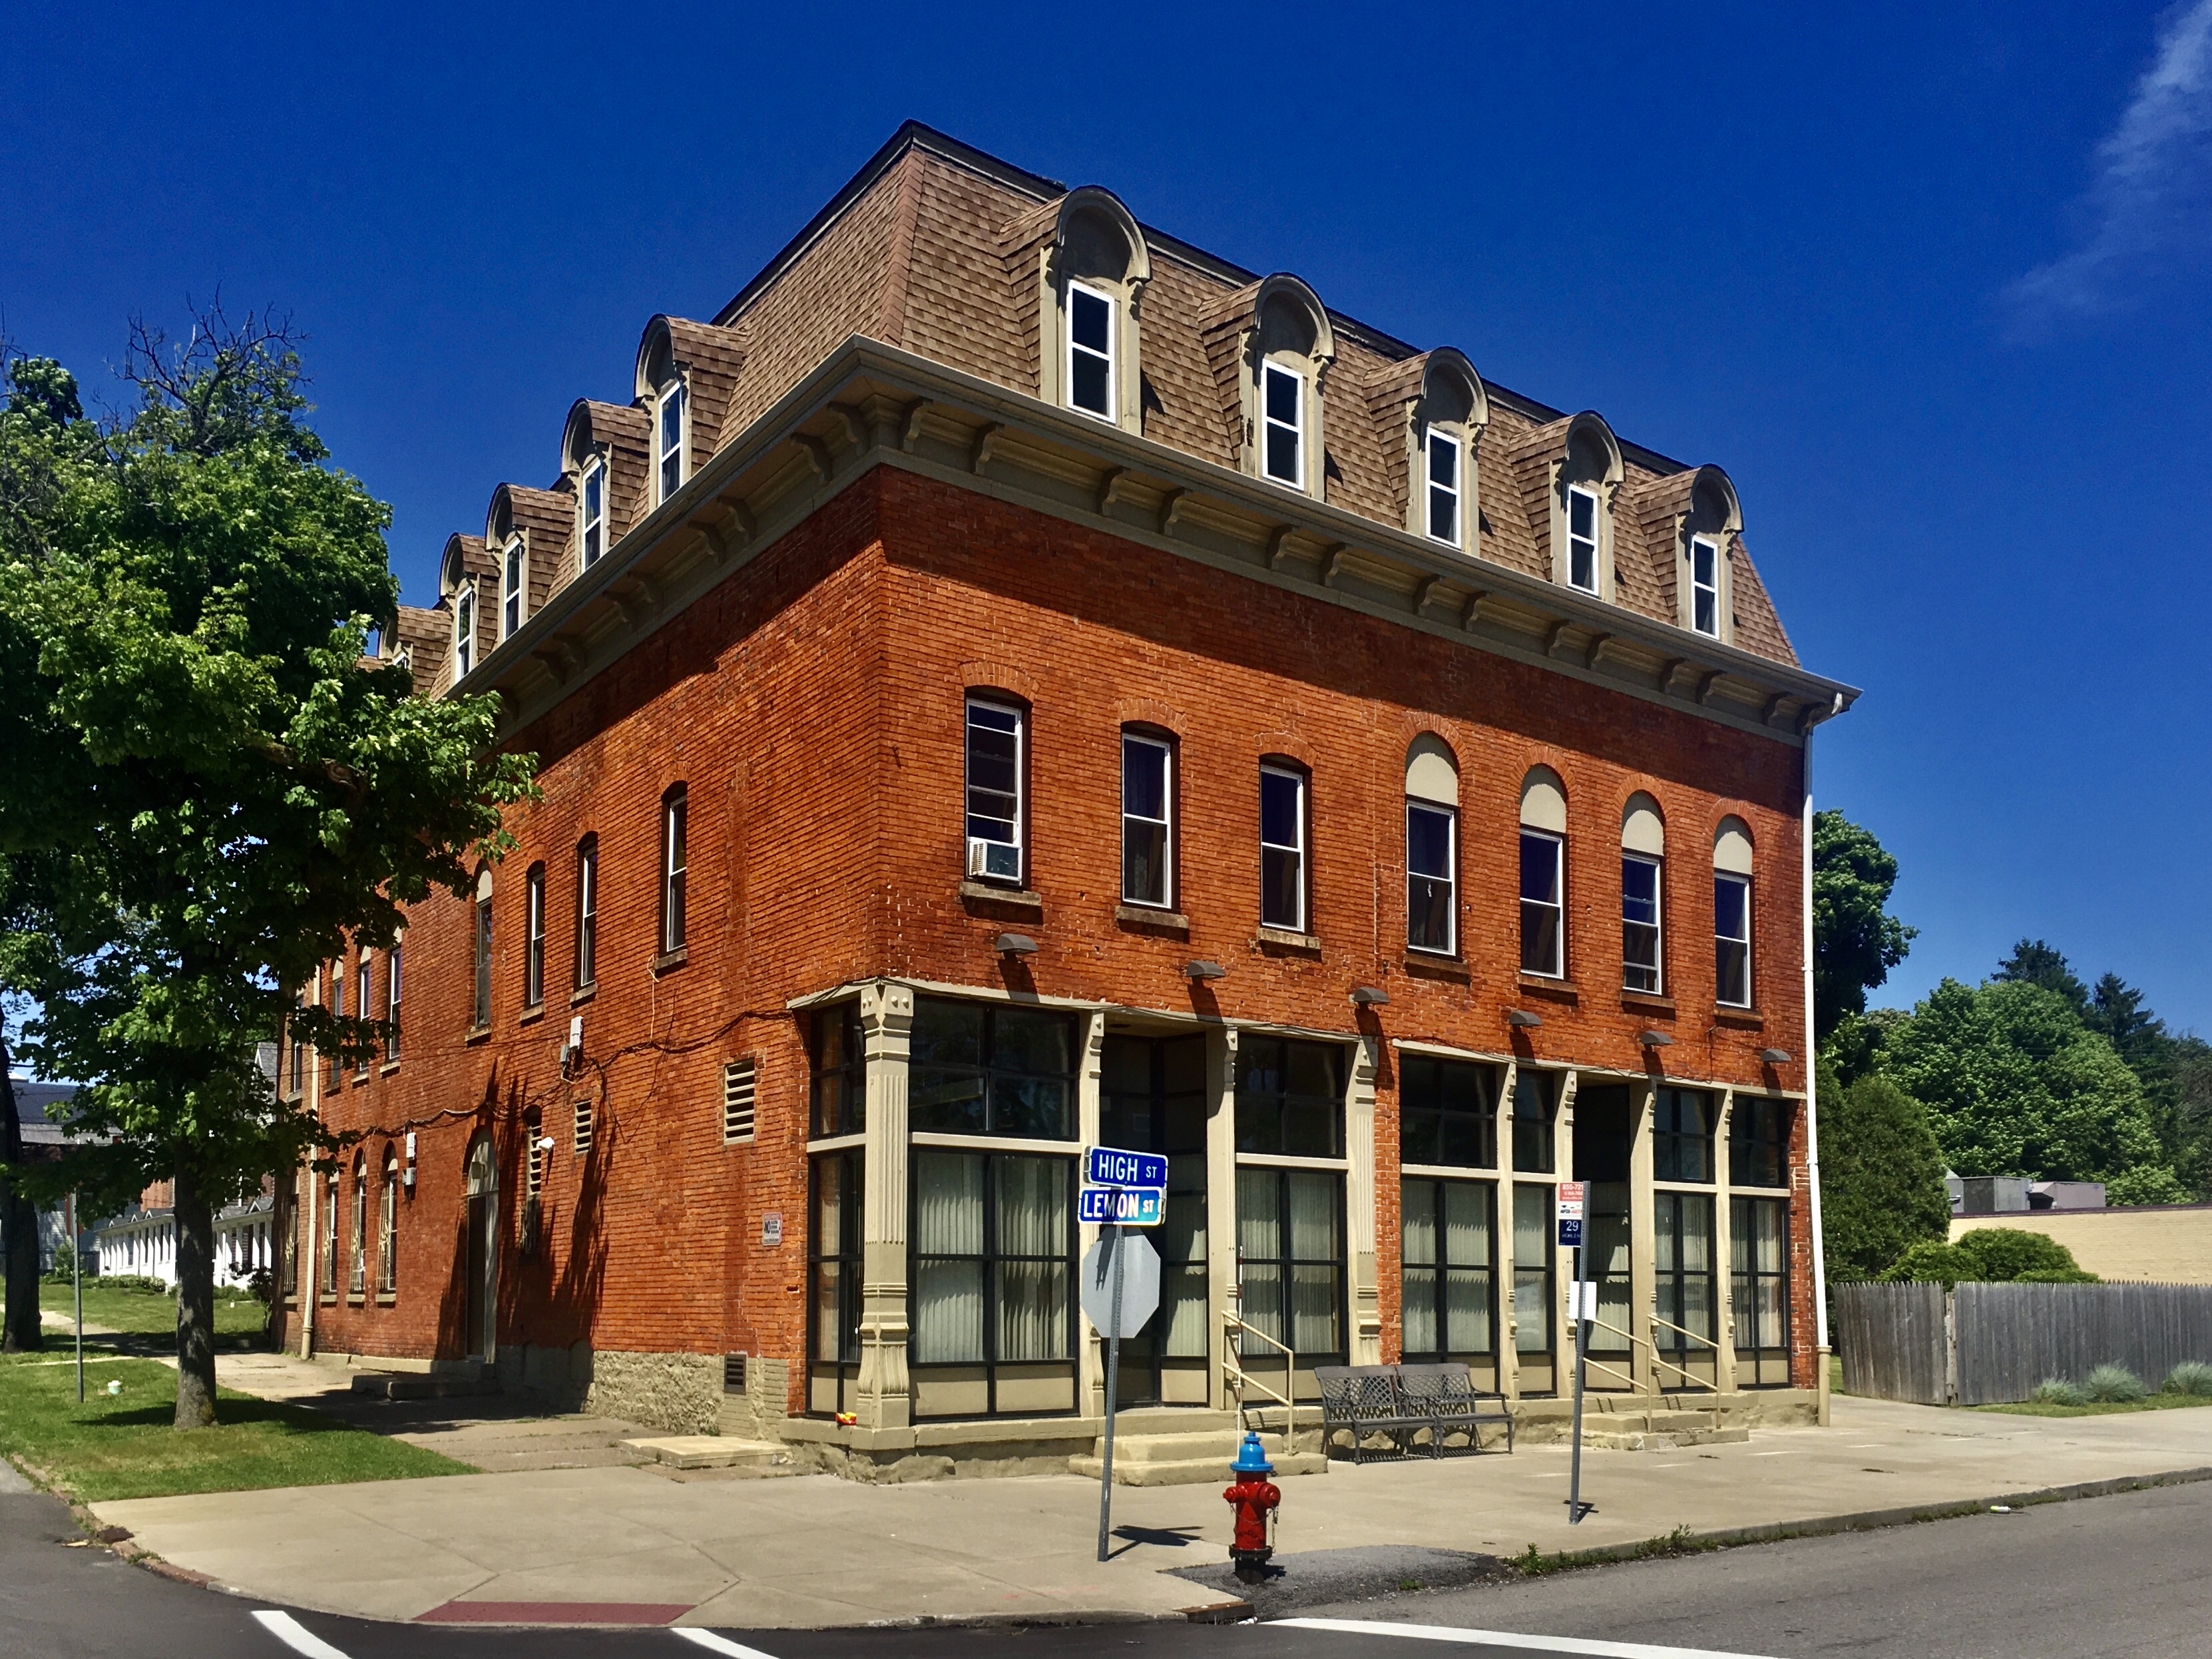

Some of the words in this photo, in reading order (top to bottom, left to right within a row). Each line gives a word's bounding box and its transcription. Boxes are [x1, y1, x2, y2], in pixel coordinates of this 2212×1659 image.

[1098, 1154, 1138, 1182] HIGH
[1146, 1166, 1158, 1179] ST
[1084, 1194, 1140, 1218] LEMON
[1143, 1200, 1154, 1213] ST
[1566, 1220, 1579, 1232] 29
